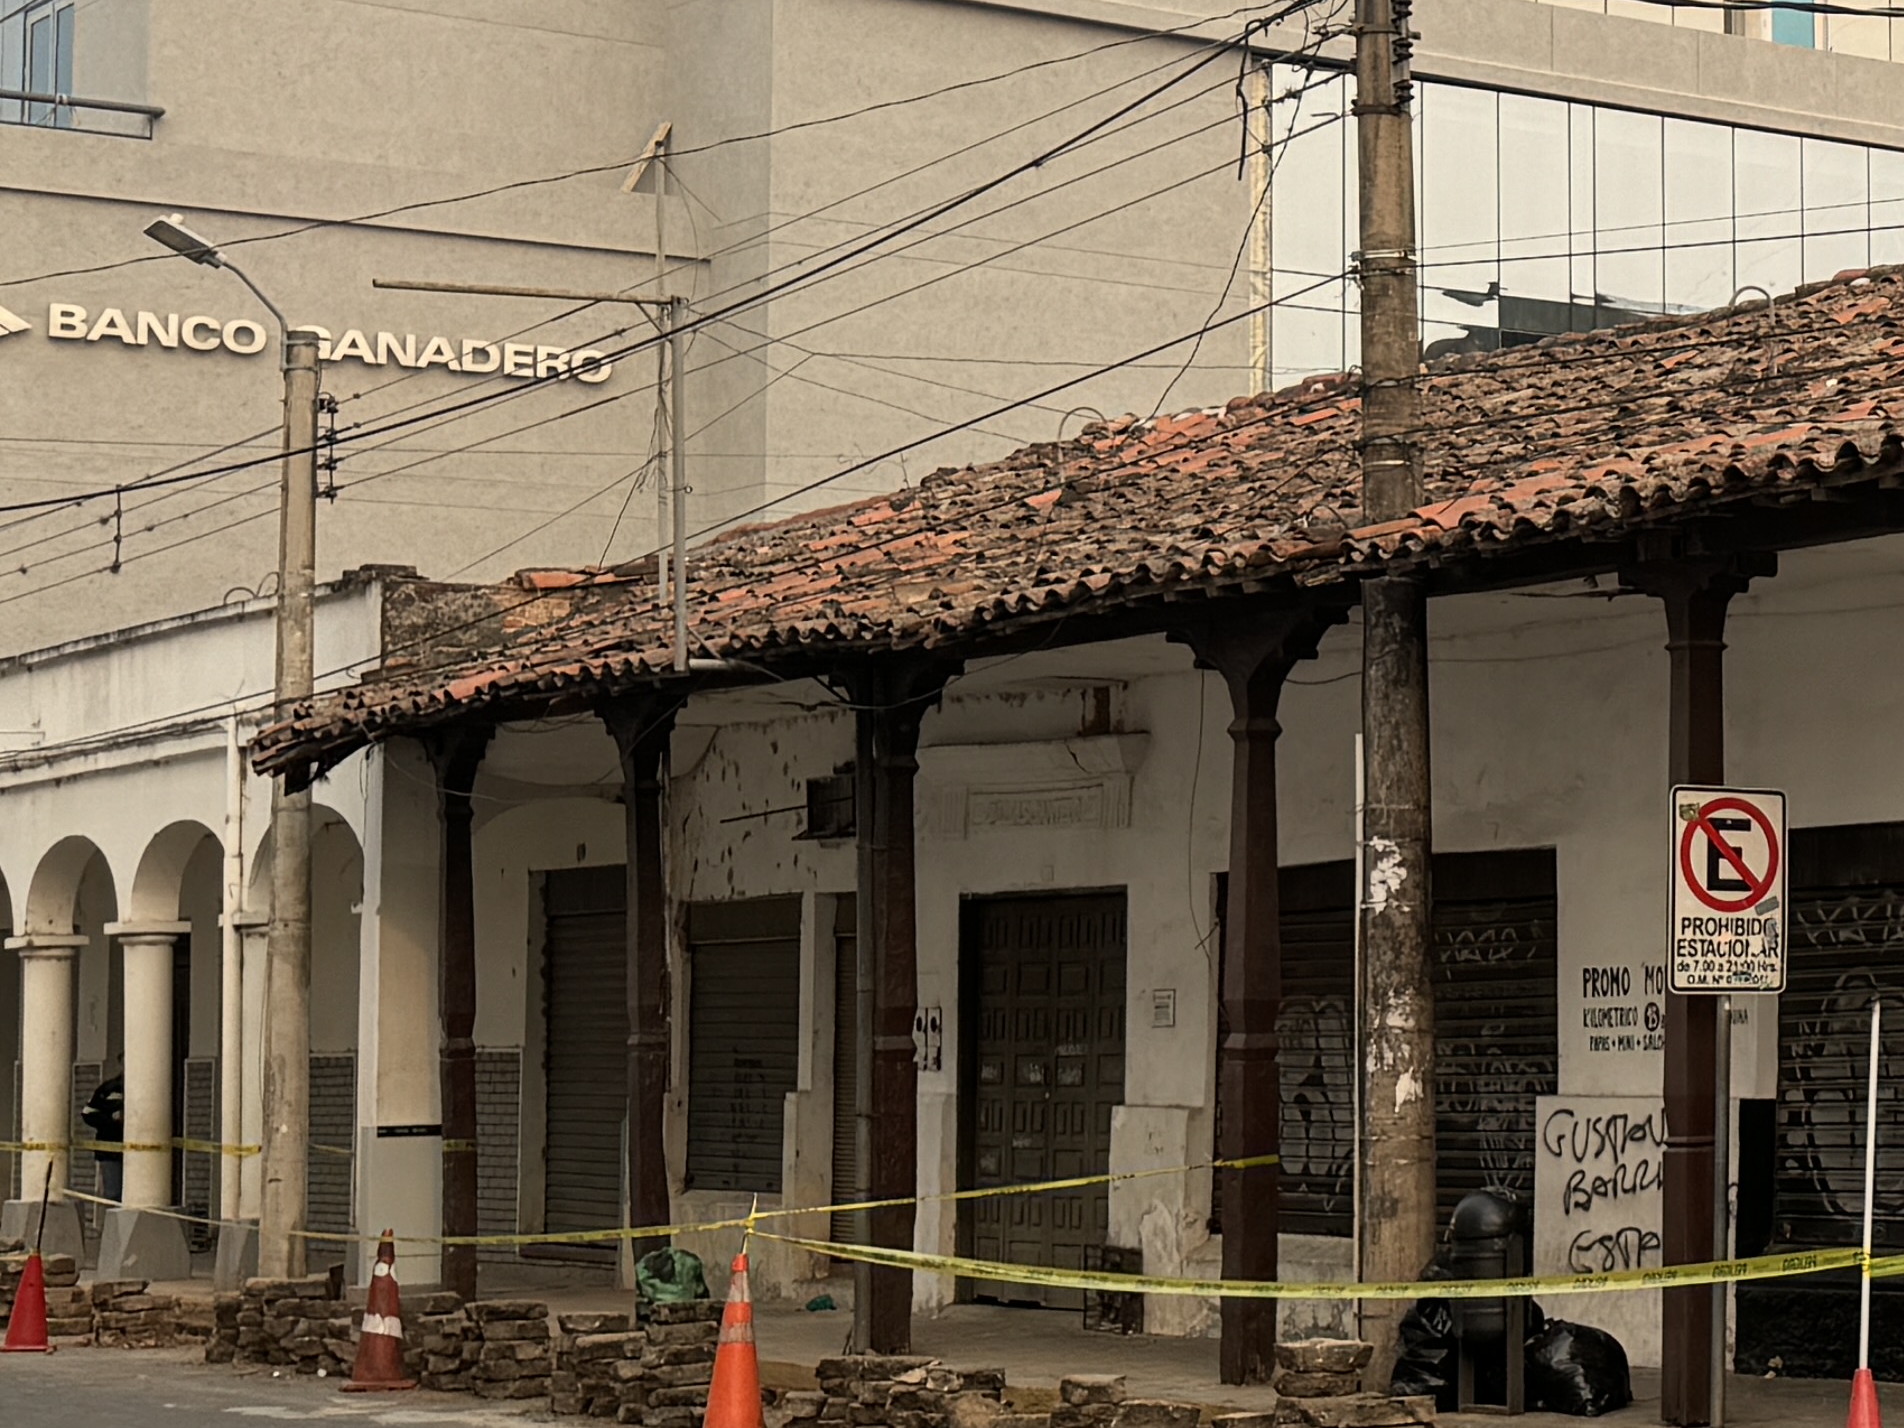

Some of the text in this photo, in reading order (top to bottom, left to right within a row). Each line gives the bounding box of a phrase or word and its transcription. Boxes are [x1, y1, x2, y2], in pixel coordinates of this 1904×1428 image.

[48, 302, 268, 355] BANCO
[1582, 966, 1631, 998] PROMO
[1677, 959, 1692, 972] de
[1717, 961, 1725, 973] a
